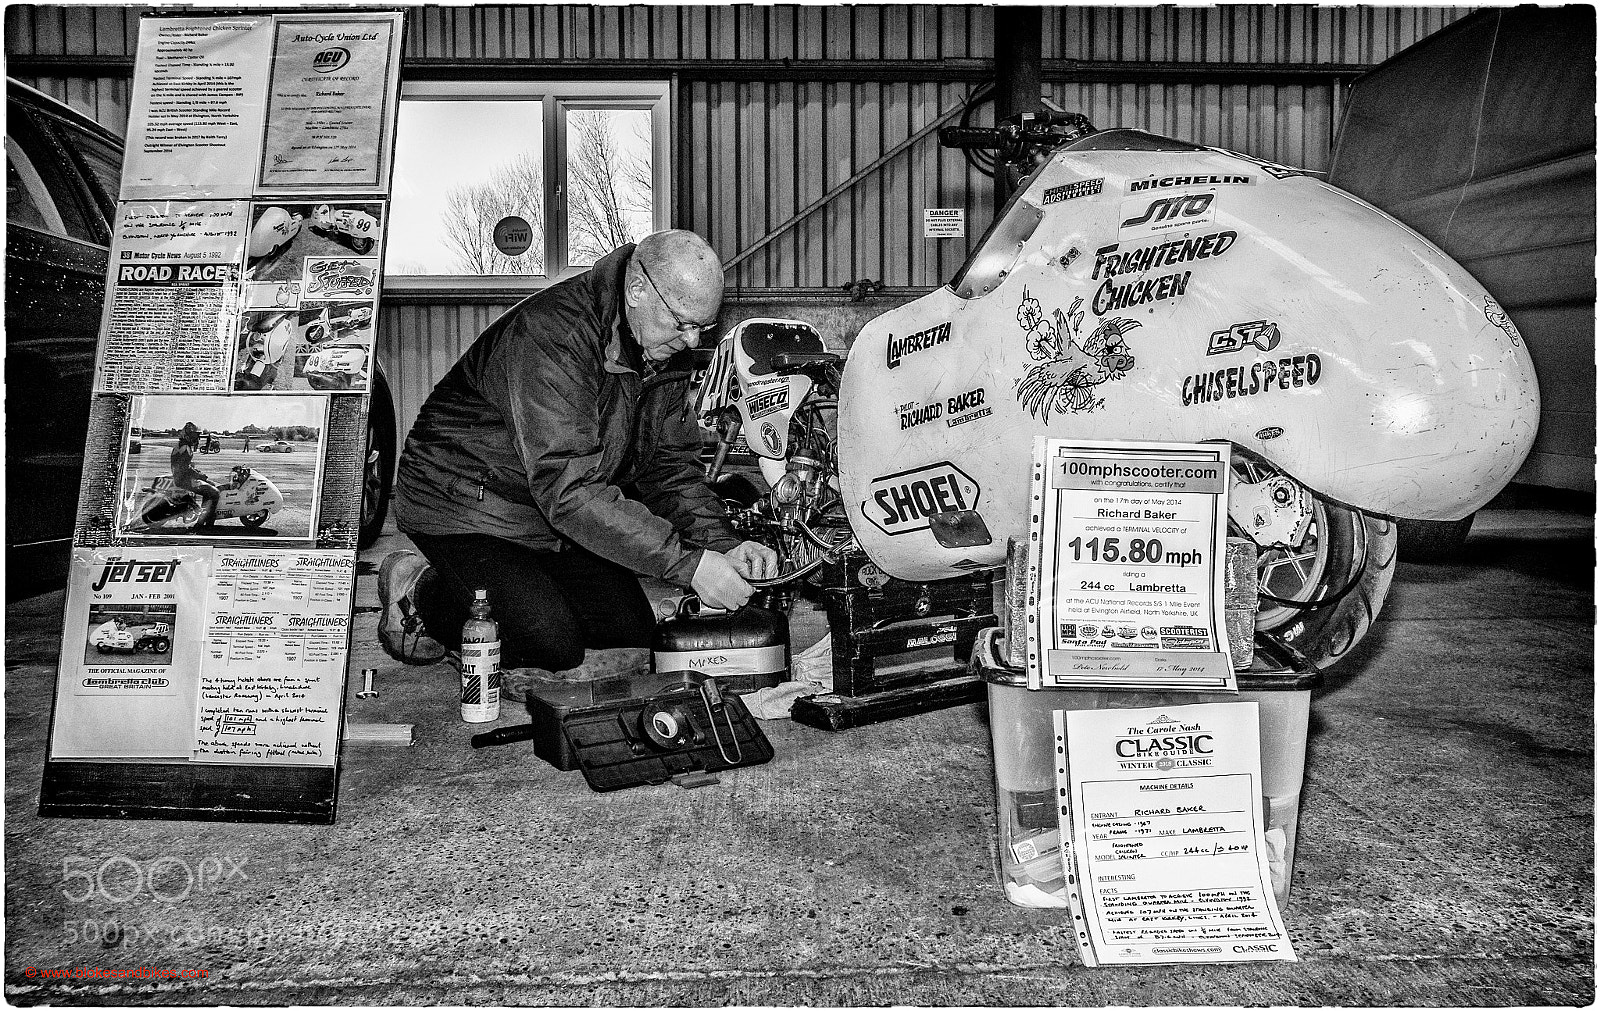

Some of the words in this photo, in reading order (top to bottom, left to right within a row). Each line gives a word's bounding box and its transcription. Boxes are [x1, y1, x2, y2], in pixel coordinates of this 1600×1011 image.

[337, 33, 360, 41] Union
[362, 33, 379, 41] Ltd
[314, 52, 344, 64] ACU
[1130, 175, 1250, 192] MICHELIN
[1174, 220, 1191, 228] spare
[151, 252, 166, 260] Cycle
[183, 252, 202, 260] August
[1091, 230, 1239, 280] FRIGHTENED
[120, 266, 172, 280] ROAD
[1092, 270, 1192, 317] CHICKEN
[886, 321, 951, 370] LAMBRETTA
[1182, 353, 1321, 407] CHISELSPEED
[749, 391, 788, 414] WISECO
[900, 404, 943, 431] RICHARD
[947, 387, 985, 422] BAKER
[1060, 462, 1217, 484] 100mphscooter.com
[874, 473, 967, 526] SHOEI
[1131, 498, 1142, 506] day
[1097, 508, 1141, 519] Richard
[1144, 509, 1178, 520] Baker
[1068, 537, 1163, 563] 115.80
[1165, 548, 1203, 568] mph
[220, 557, 280, 568] STRAIGHTLINERS
[1080, 580, 1101, 590] 244
[1129, 582, 1187, 593] Lambretta
[214, 615, 274, 626] STRAIGHTLINERS
[288, 616, 348, 627] STRAIGHTLINERS
[1160, 628, 1208, 636] SCOOTERIST
[906, 632, 957, 648] MALOSSI
[688, 655, 728, 668] MIXED
[87, 668, 100, 676] THE
[100, 668, 127, 676] OFFICIAL
[128, 668, 158, 676] MAGAZINE
[158, 668, 167, 676] OF
[1126, 727, 1145, 735] The
[1146, 725, 1177, 735] Carole
[1178, 723, 1202, 732] Nash
[1115, 735, 1214, 758] CLASSIC
[1120, 761, 1154, 769] WINTER
[1175, 759, 1212, 768] CLASSIC
[1090, 812, 1118, 820] ENTRANT
[1134, 808, 1171, 816] RICHARD
[1176, 805, 1207, 814] BAKER
[1182, 826, 1226, 834] LAMBRETTA
[1098, 873, 1136, 882] INTERESTING
[1231, 943, 1279, 954] CLASSIC
